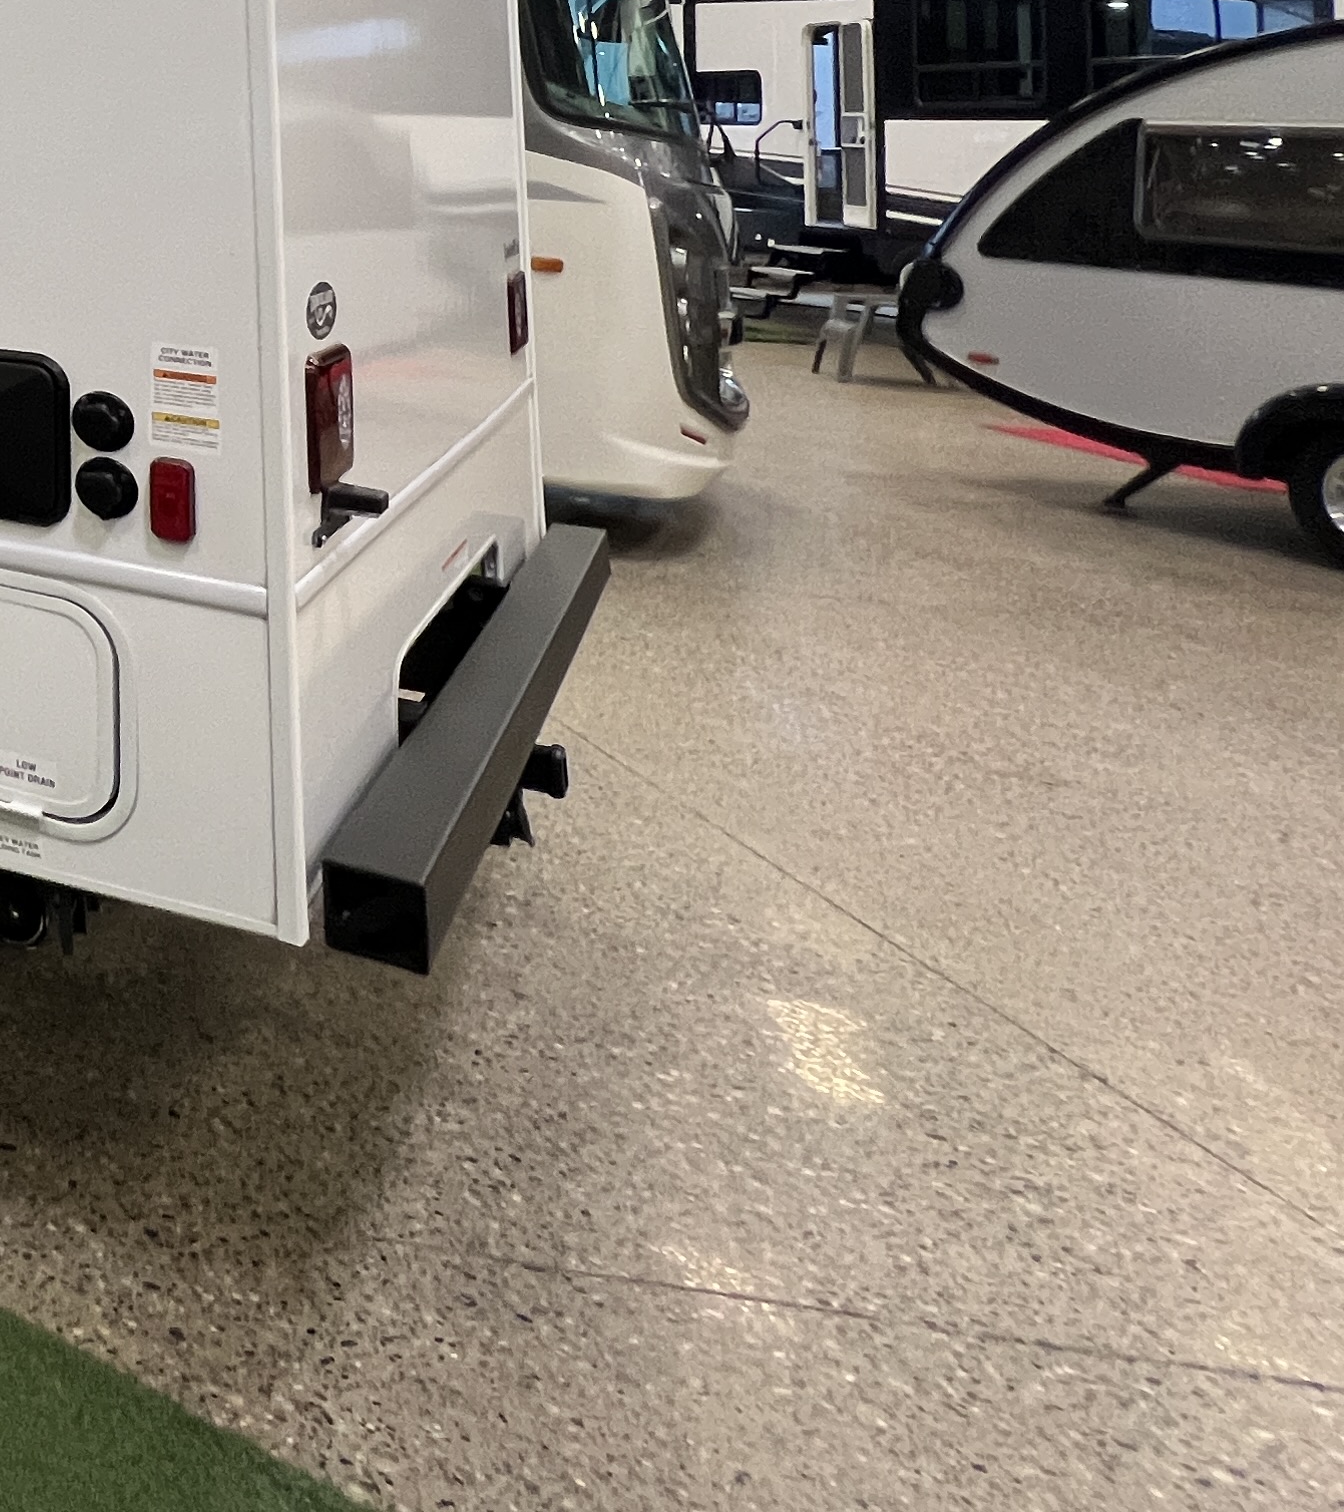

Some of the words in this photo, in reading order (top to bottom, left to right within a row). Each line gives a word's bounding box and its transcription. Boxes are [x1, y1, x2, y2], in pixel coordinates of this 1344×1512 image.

[160, 347, 179, 356] CITY
[181, 349, 209, 359] WATER
[16, 759, 37, 772] LOW
[27, 773, 56, 789] DRAIN
